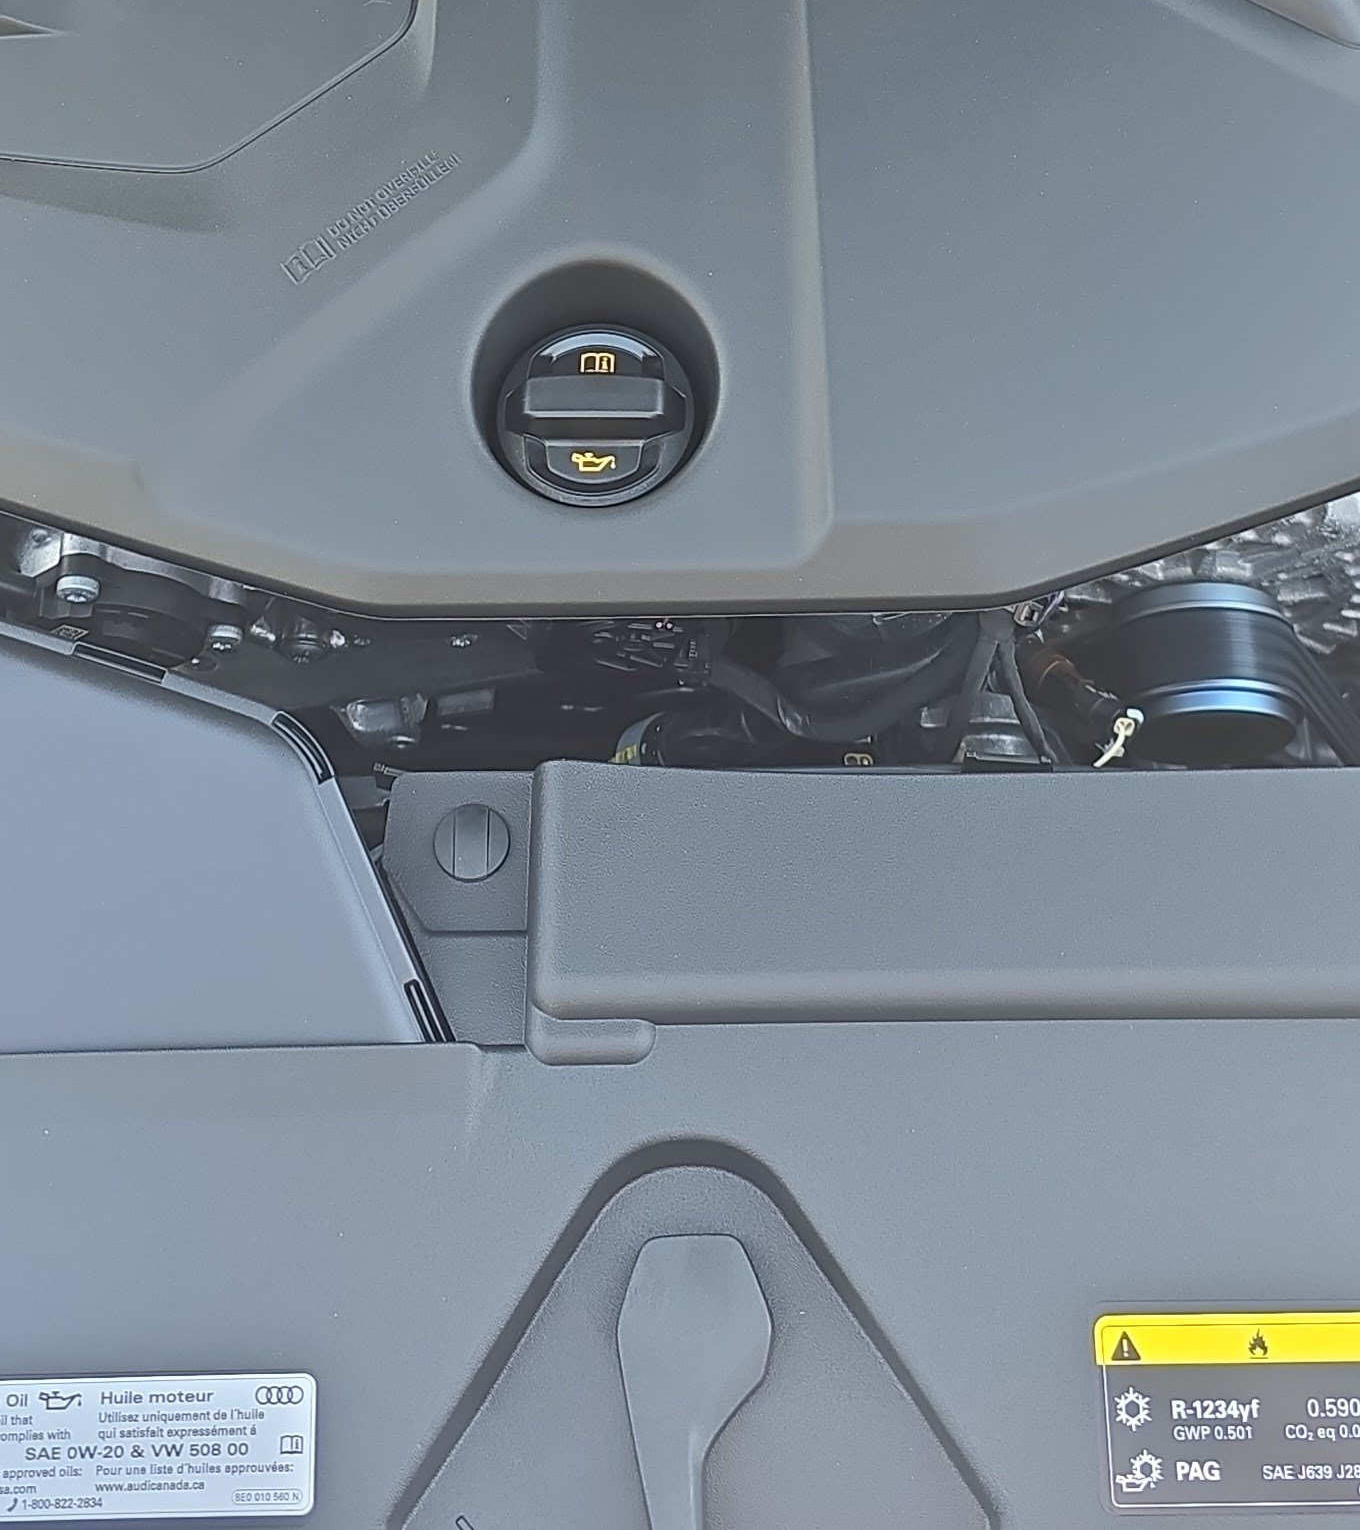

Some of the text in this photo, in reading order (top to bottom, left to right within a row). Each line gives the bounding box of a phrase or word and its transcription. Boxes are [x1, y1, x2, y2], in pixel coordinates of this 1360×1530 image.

[327, 218, 350, 238] DO
[347, 196, 377, 224] NOT
[337, 214, 379, 250] NICHT
[6, 1393, 28, 1407] Oil
[101, 1390, 214, 1405] Huile moteur
[98, 1411, 139, 1424] Utilisez
[142, 1409, 210, 1425] uniquement
[213, 1409, 227, 1420] de
[1171, 1399, 1260, 1423] R-1234yf
[1307, 1398, 1360, 1418] 0.590
[11, 1414, 33, 1426] that
[47, 1429, 71, 1440] with
[98, 1427, 116, 1441] qui
[119, 1426, 164, 1439] satisfait
[167, 1425, 242, 1440] expressément
[1173, 1426, 1210, 1440] GWP
[1213, 1425, 1253, 1440] 0.501
[1316, 1427, 1336, 1442] eq
[25, 1442, 249, 1461] SAE 0W-20 & VW 508 00
[2, 1467, 56, 1481] approved
[59, 1465, 83, 1477] oils:
[95, 1465, 122, 1476] Pour
[125, 1466, 146, 1475] une
[149, 1464, 173, 1475] liste
[1176, 1461, 1221, 1481] PAG
[1262, 1465, 1295, 1480] SAE
[1297, 1465, 1332, 1480] J639
[94, 1480, 205, 1492] www.audicanada.ca
[21, 1497, 103, 1510] 1-800-822-2834
